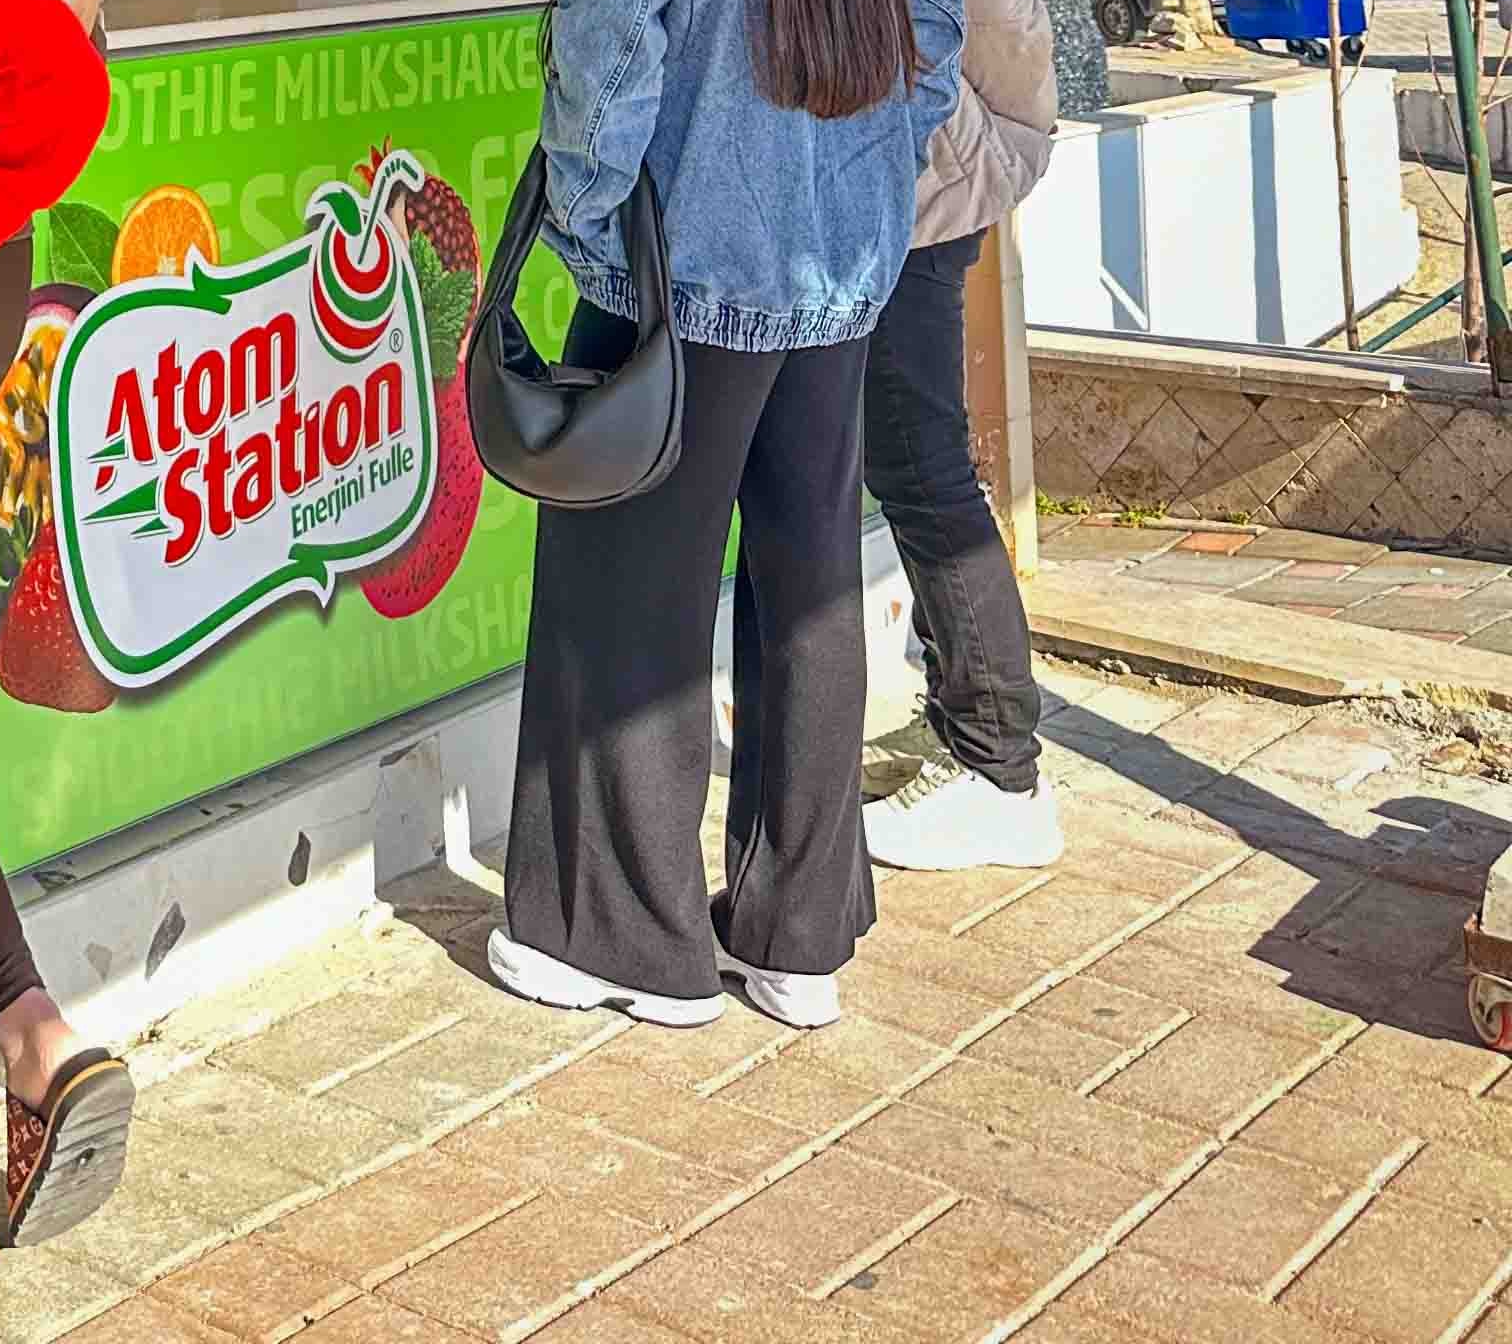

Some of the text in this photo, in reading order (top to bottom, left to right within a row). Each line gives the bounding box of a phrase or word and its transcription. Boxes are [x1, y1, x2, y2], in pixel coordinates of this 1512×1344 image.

[97, 25, 539, 151] OTHIE MILKSHAKE
[98, 311, 300, 464] Atom
[162, 361, 406, 566] Station
[291, 442, 415, 539] Enerjini Fulle
